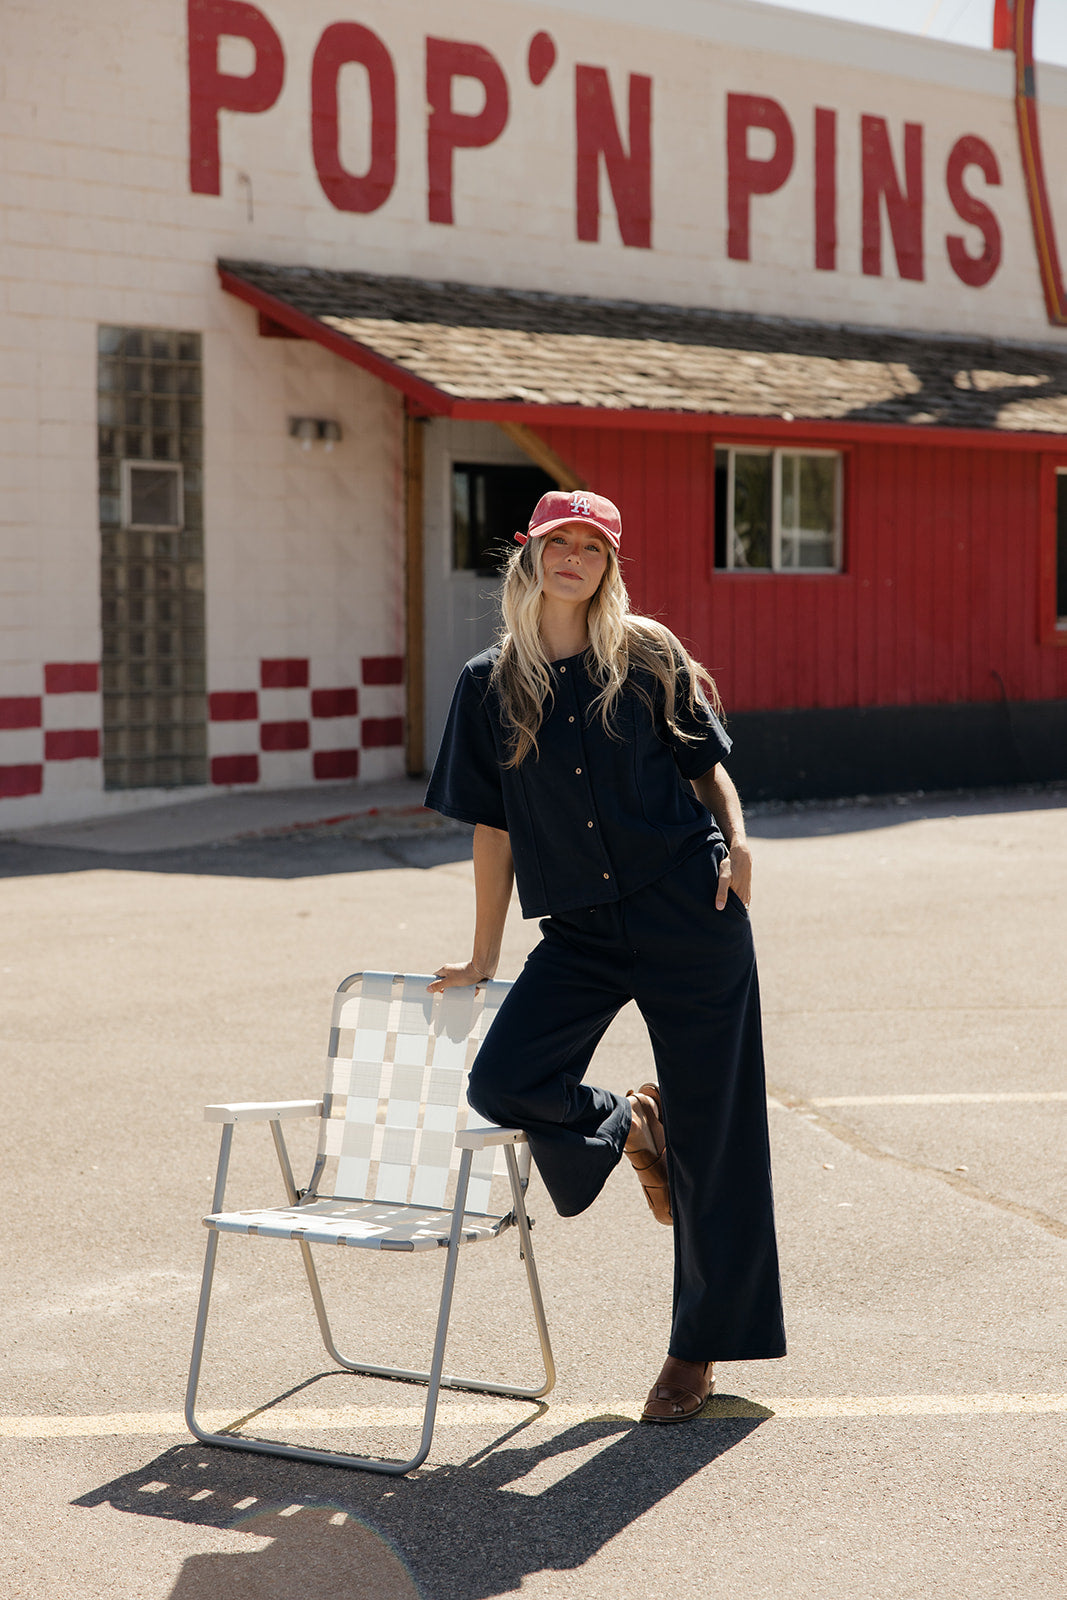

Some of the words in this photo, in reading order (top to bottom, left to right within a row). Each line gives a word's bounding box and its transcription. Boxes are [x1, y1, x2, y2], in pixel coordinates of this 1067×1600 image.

[187, 0, 652, 249] POP'N
[726, 92, 1003, 288] PINS
[570, 493, 591, 516] LA
